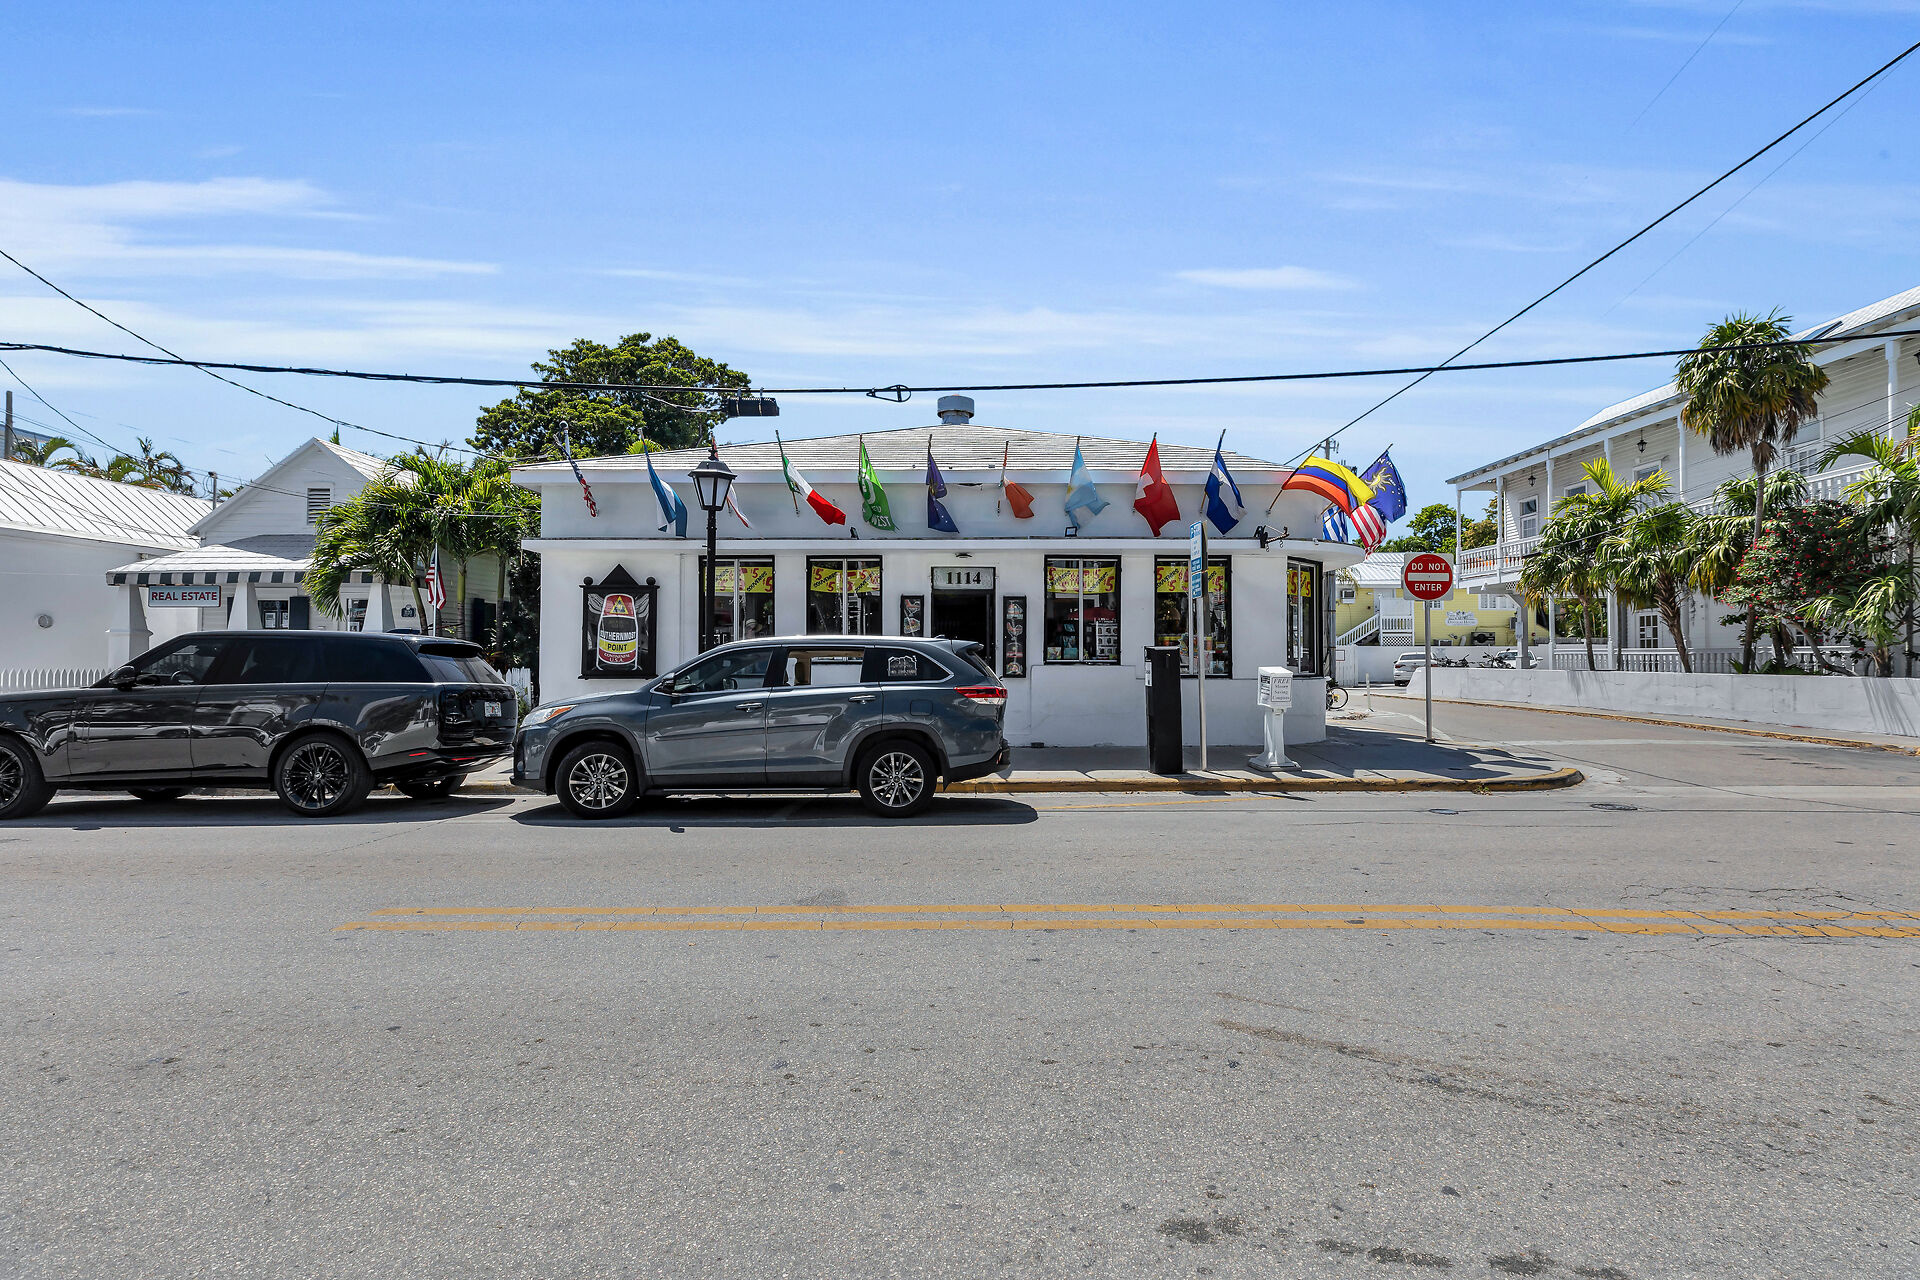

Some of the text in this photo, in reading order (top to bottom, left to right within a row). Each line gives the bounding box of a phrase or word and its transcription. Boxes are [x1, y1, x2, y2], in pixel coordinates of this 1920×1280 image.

[1411, 562, 1445, 570] DO NOT
[946, 571, 981, 585] 1114
[1414, 583, 1442, 591] ENTER
[151, 591, 217, 600] REAL ESTATE
[607, 643, 628, 651] POINT
